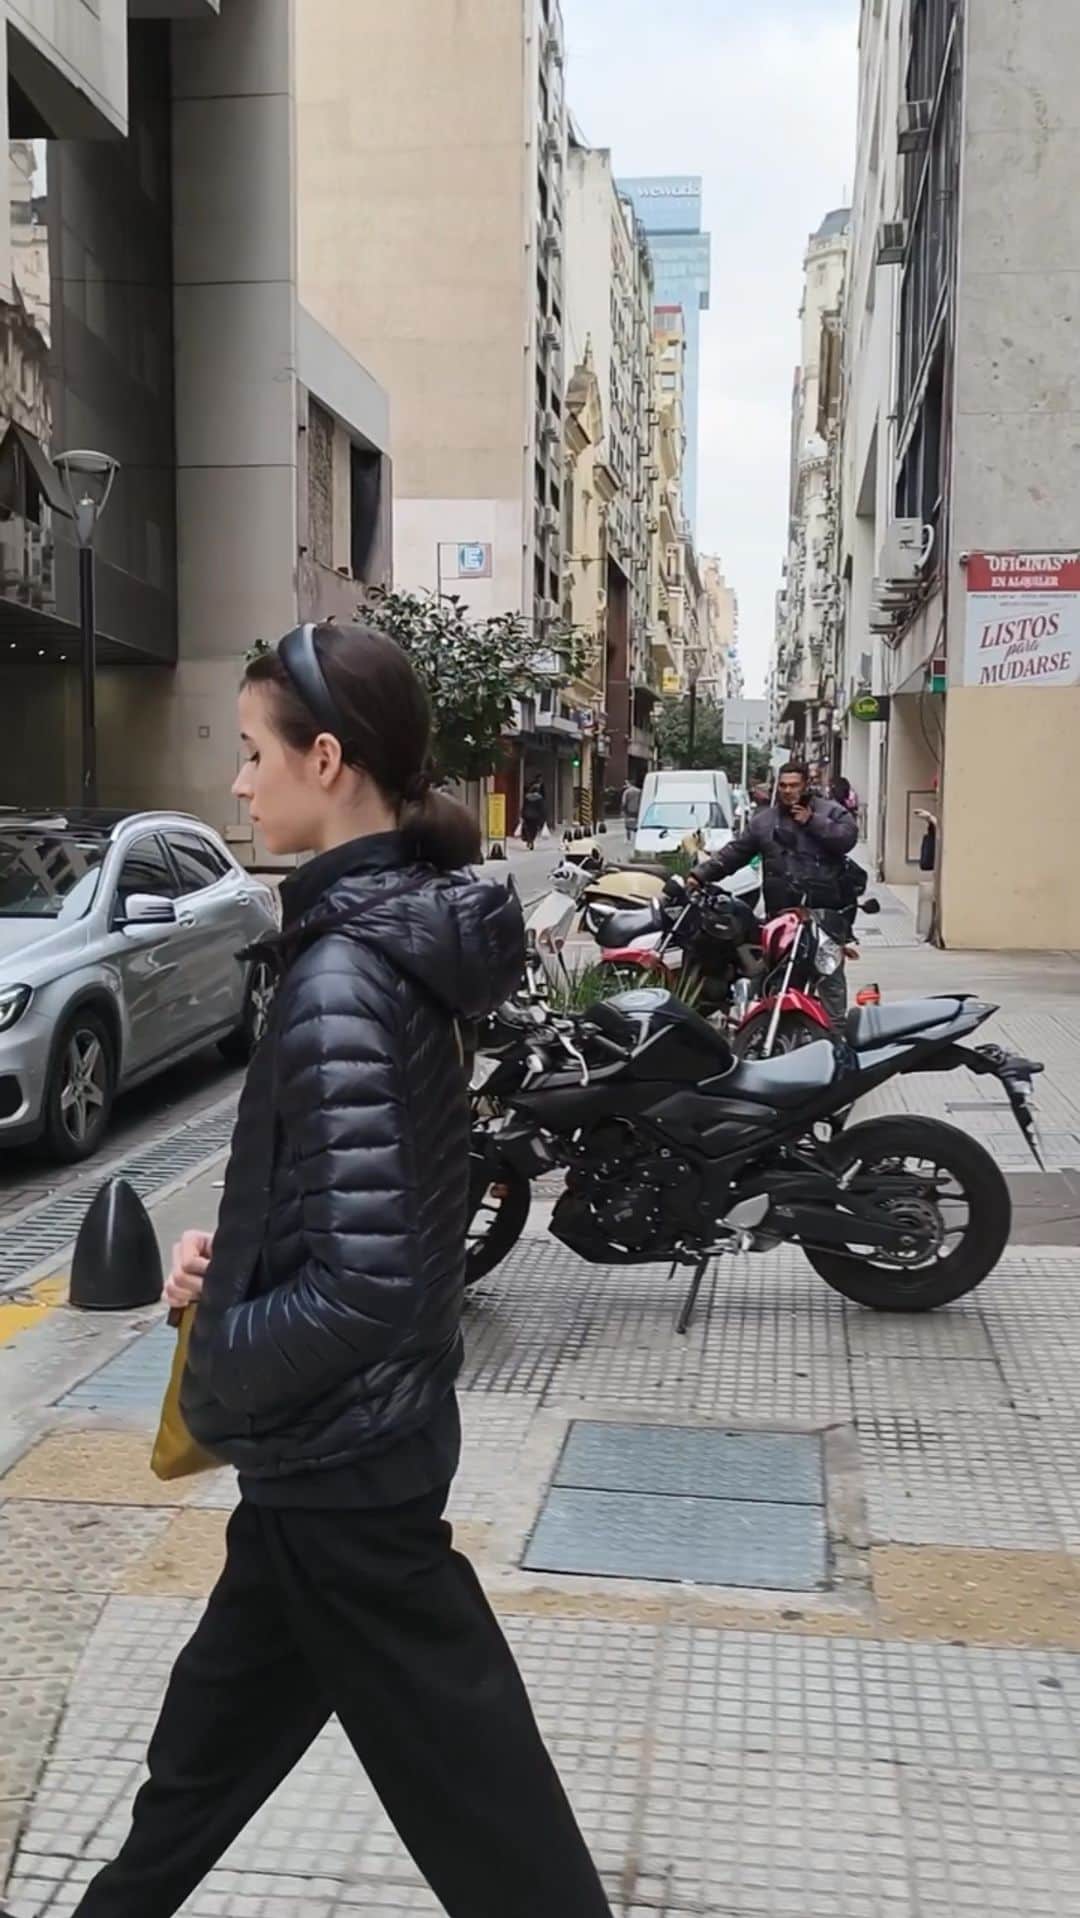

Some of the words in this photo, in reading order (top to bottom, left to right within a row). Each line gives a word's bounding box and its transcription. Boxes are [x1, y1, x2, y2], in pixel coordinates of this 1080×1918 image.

[464, 546, 481, 569] E
[989, 555, 1062, 571] OFICINAS
[991, 576, 1006, 587] EN
[1007, 576, 1059, 588] ALQUILER
[980, 613, 1060, 648] LISTOS
[980, 651, 1072, 685] MUDARSE
